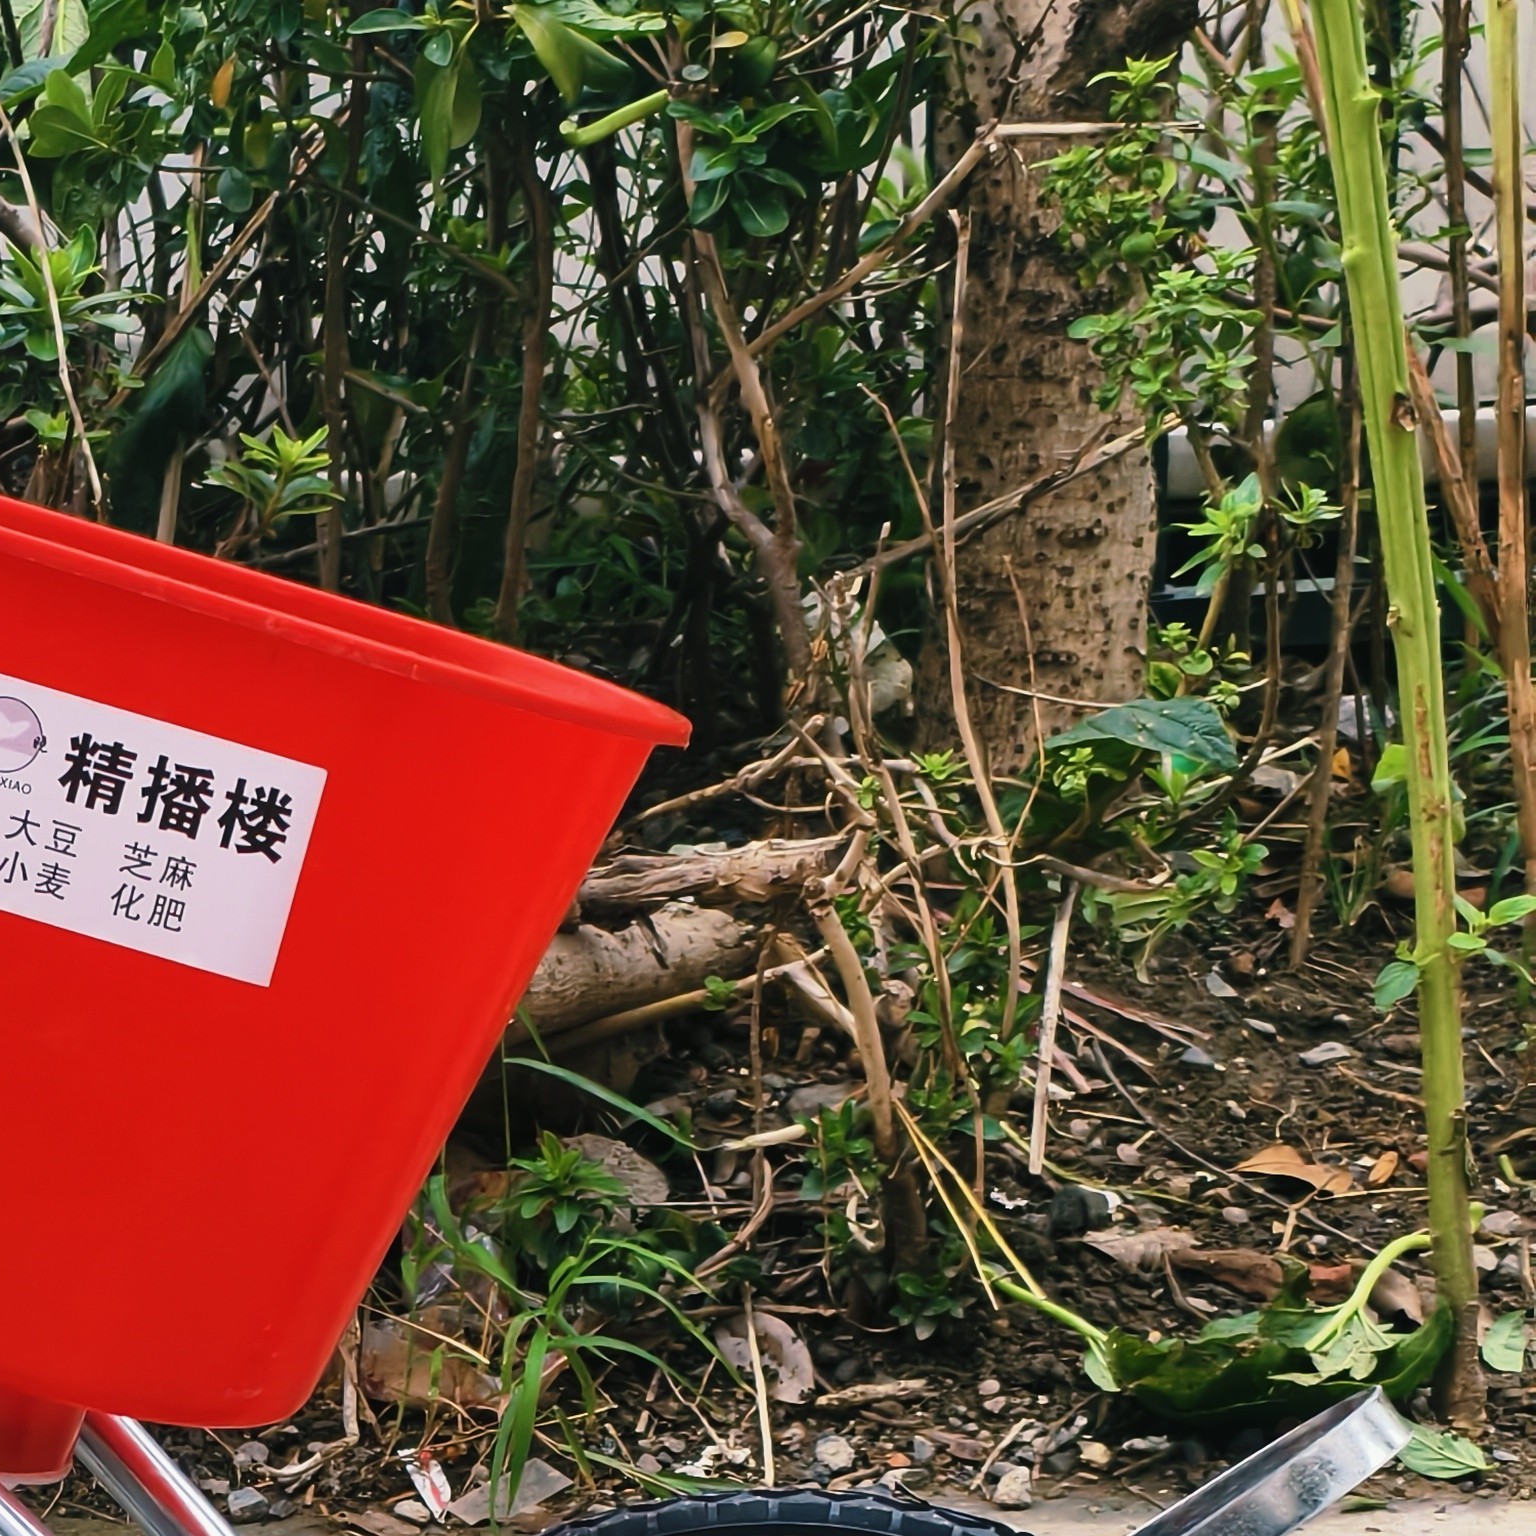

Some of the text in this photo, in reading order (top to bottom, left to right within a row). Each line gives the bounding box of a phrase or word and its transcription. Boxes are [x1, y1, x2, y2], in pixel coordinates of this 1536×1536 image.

[0, 776, 32, 795] XIAO
[57, 732, 293, 865] 精播楼
[4, 809, 83, 858] 大豆
[118, 841, 198, 892] 芝麻
[110, 882, 186, 933] 化肥
